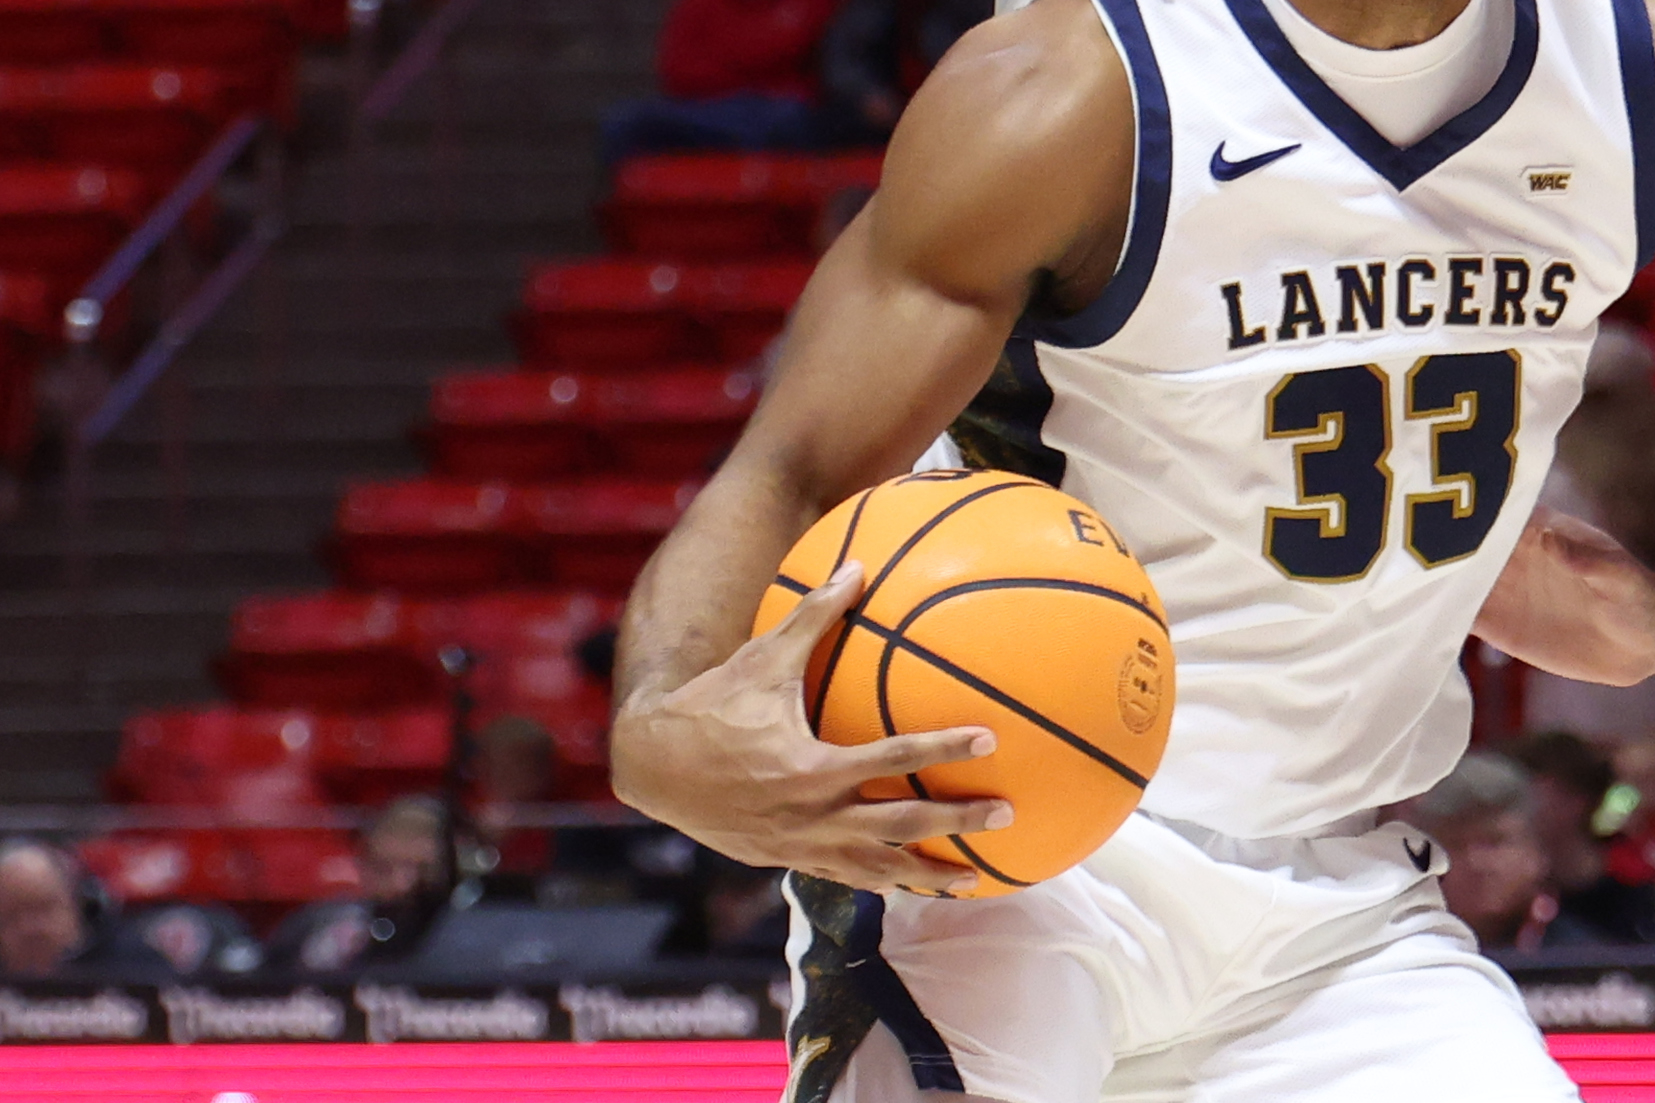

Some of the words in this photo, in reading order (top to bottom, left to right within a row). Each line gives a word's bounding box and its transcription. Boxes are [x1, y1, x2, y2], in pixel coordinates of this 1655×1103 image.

[1528, 171, 1572, 191] WAC
[1221, 257, 1576, 350] LANCERS
[1264, 348, 1523, 585] 33
